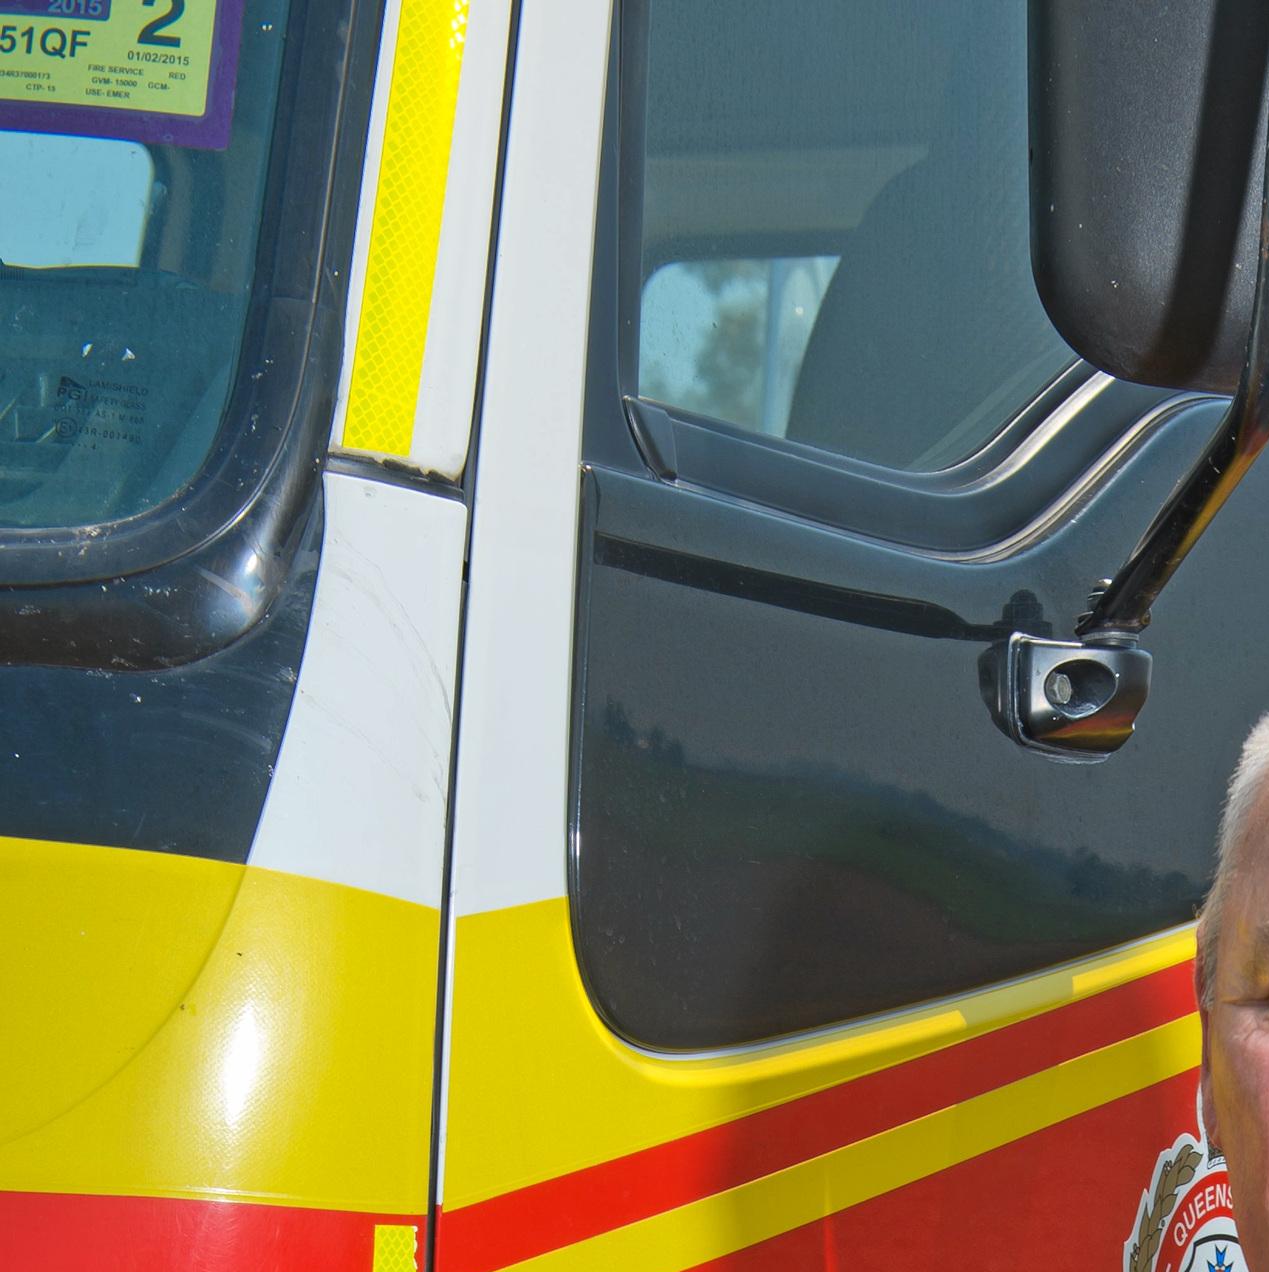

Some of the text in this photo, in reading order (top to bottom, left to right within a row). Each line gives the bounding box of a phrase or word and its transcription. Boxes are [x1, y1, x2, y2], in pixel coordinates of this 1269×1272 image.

[47, 0, 102, 15] 2015
[137, 0, 185, 48] 2
[127, 50, 190, 66] 01/02/2015
[88, 64, 144, 76] FIRE SERVICE
[168, 72, 186, 80] RED
[106, 90, 131, 99] EMER
